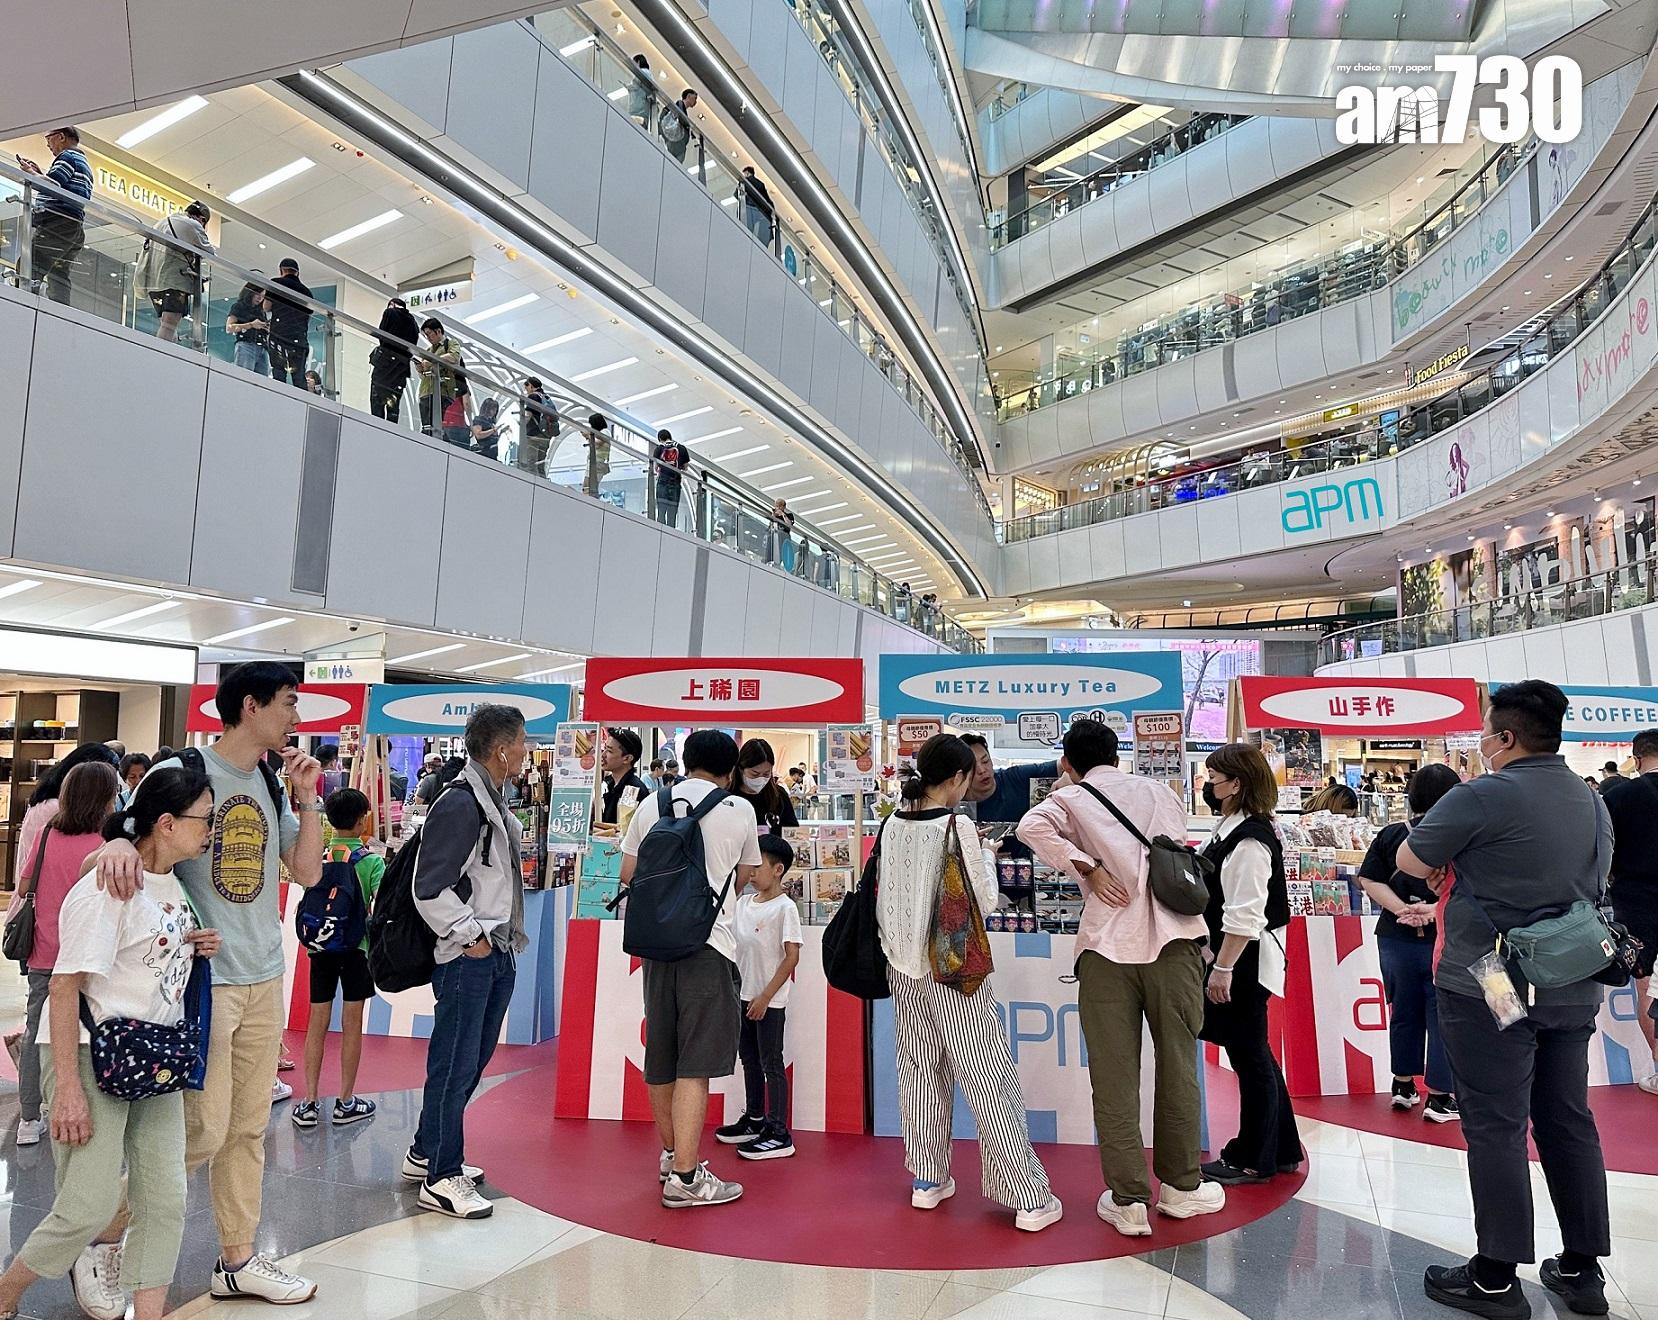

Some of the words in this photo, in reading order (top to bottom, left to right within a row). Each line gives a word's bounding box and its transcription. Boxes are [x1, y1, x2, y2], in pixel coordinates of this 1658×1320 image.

[99, 168, 127, 195] TEA
[1415, 360, 1437, 384] Food
[1438, 345, 1468, 371] Fiesta
[1281, 477, 1385, 533] apm
[681, 678, 761, 701] 上稀園
[935, 680, 990, 694] METZ
[998, 681, 1071, 697] Luxury
[1078, 679, 1118, 693] Tea
[1328, 696, 1395, 717] 山手作
[1581, 706, 1658, 722] COFFEE
[911, 730, 929, 739] $50
[1146, 722, 1170, 733] $100
[557, 801, 584, 818] 全場
[552, 818, 586, 834] 95折
